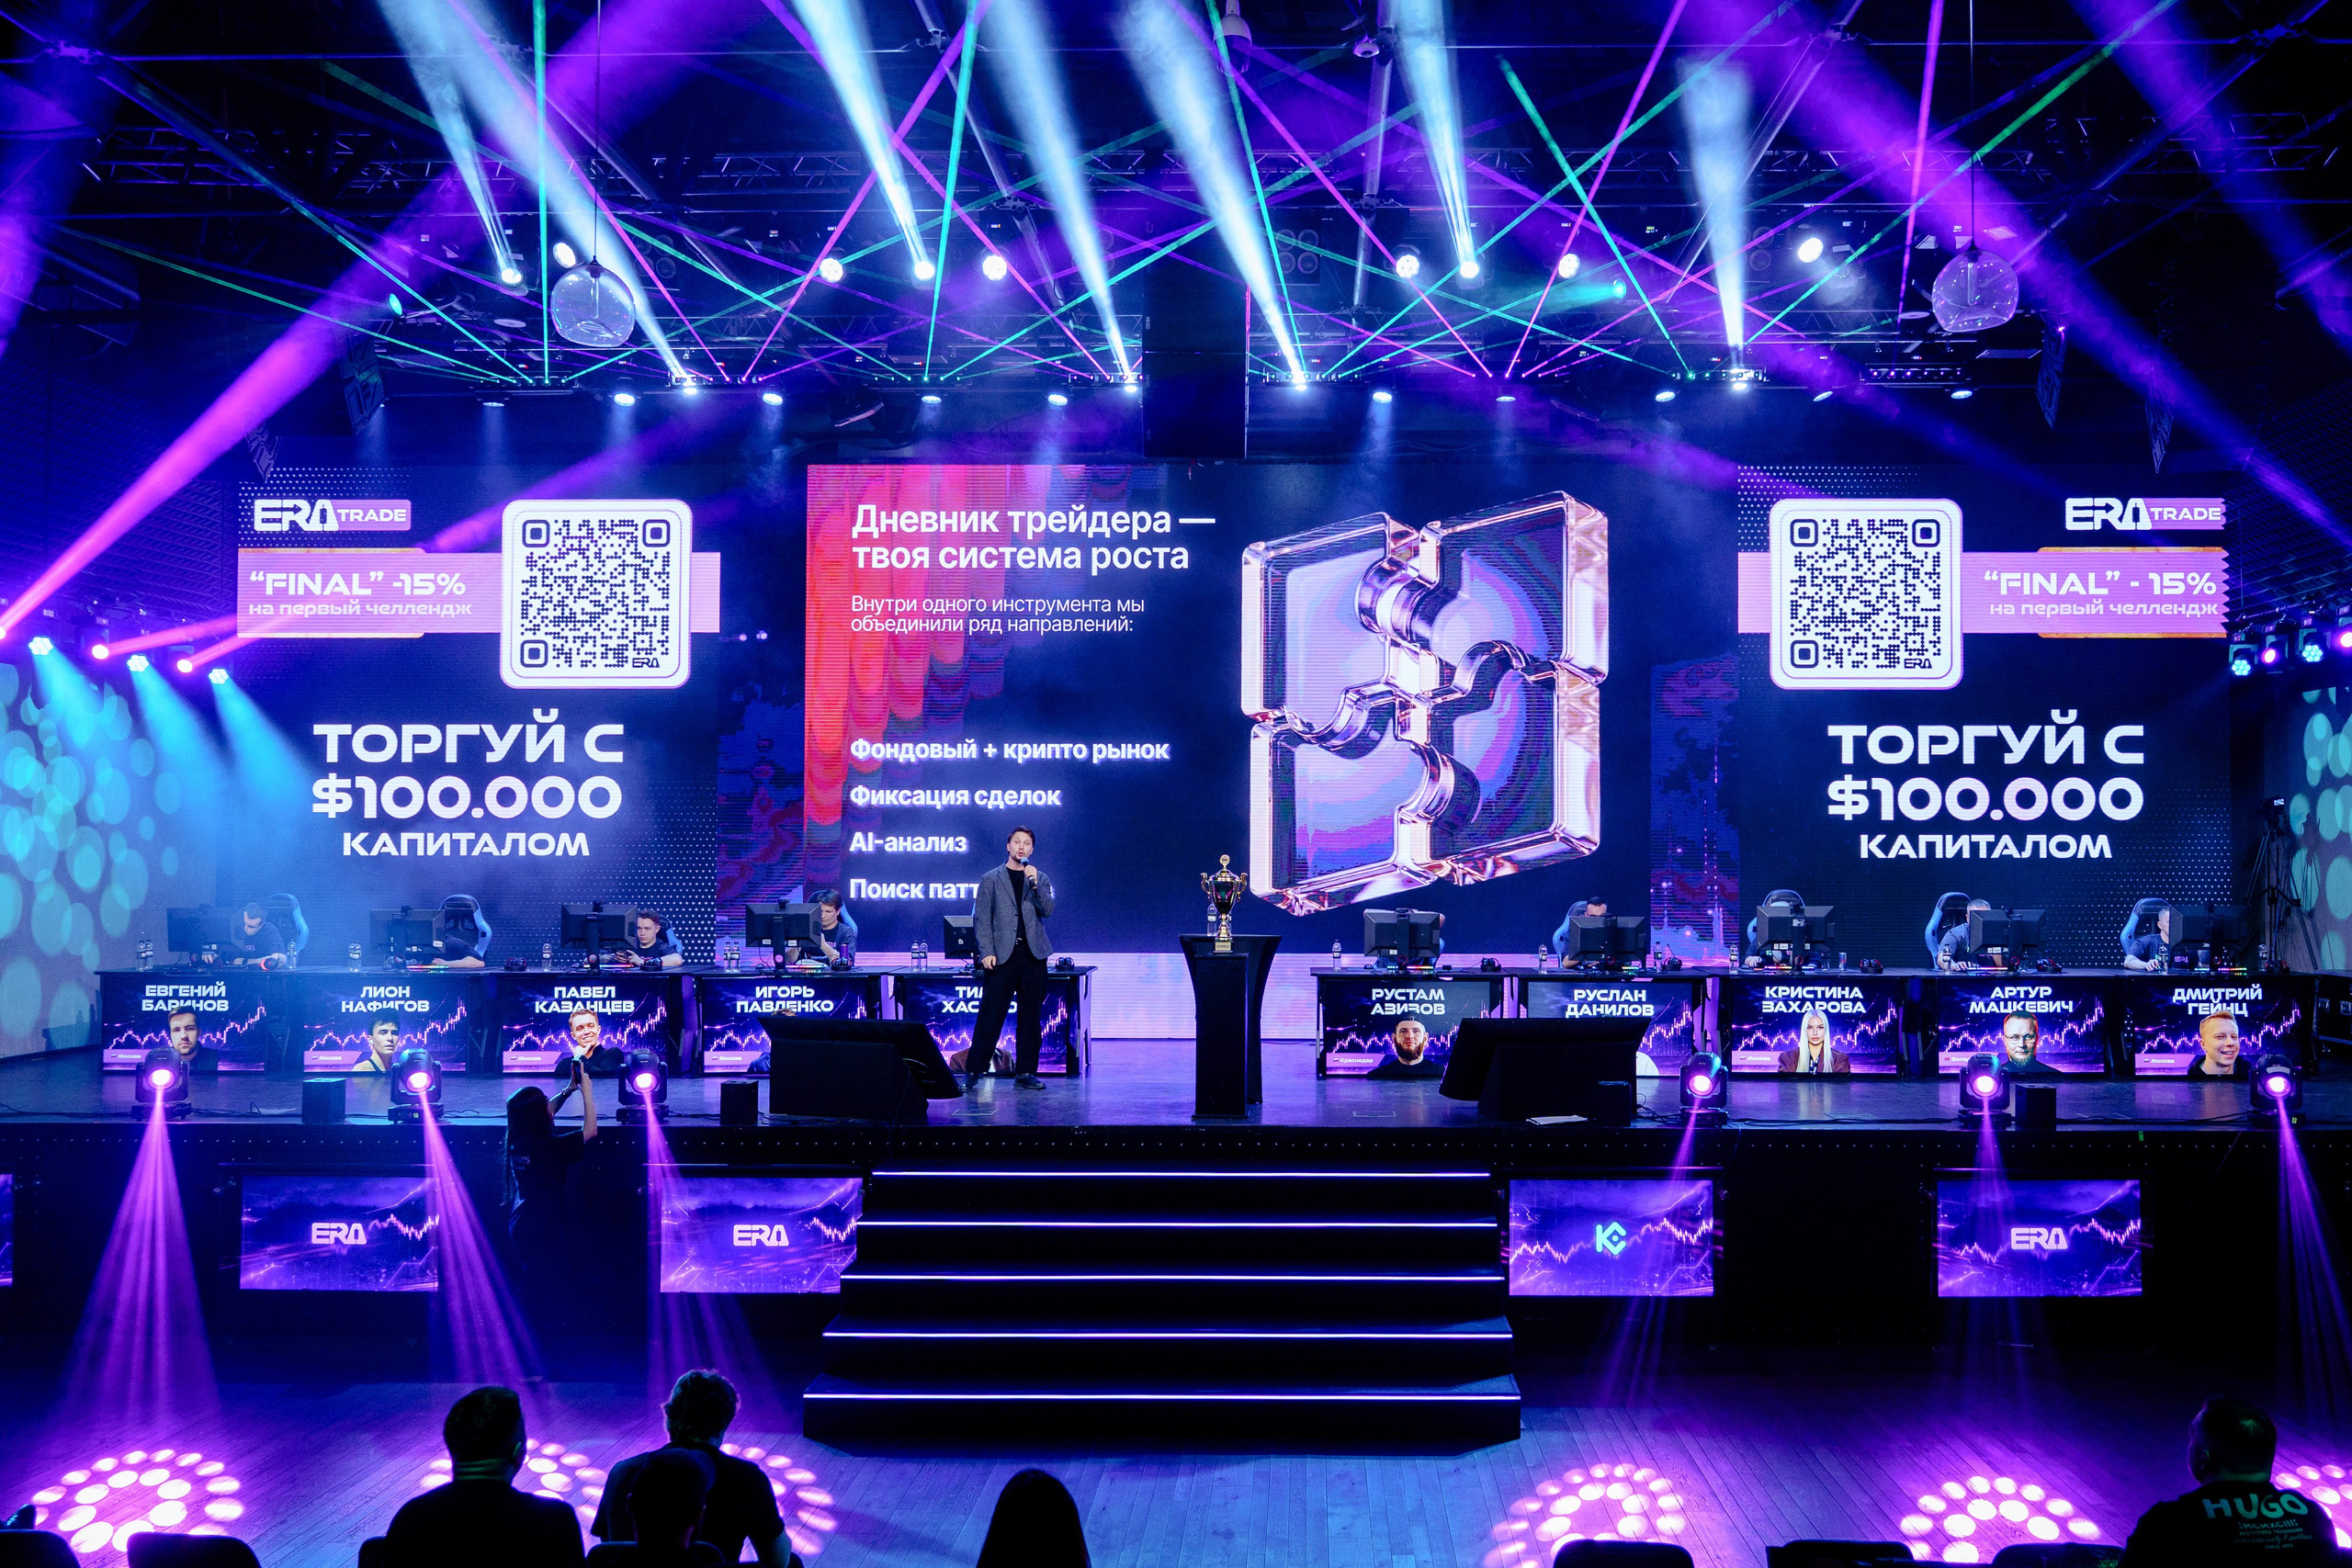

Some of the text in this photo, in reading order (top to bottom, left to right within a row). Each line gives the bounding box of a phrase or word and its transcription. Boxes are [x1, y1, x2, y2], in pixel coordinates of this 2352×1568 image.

[254, 499, 407, 532] ERA TRADE
[852, 504, 1000, 539] Дневник
[1008, 505, 1171, 540] трейдера
[2064, 497, 2222, 531] ERA TRADE
[852, 547, 1189, 576] твоя система роста
[2148, 572, 2217, 595] 15%
[248, 599, 473, 618] на первый челлендж
[852, 595, 1145, 615] Внутри одного инструмента мы
[1989, 599, 2219, 618] на первый челлендж
[851, 614, 1134, 636] объединили ряд направлений:
[631, 657, 661, 669] ERA
[1904, 658, 1933, 670] ERA
[313, 707, 625, 763] ТОРГУЙ С
[1827, 708, 2144, 765] ТОРГУЙ С
[850, 738, 977, 763] Фондовый
[1002, 743, 1088, 764] крипто
[1092, 743, 1170, 764] рынок
[311, 773, 623, 819] $100.000
[850, 784, 1061, 810] Фиксация сделок
[1827, 773, 2144, 821] $100.000
[343, 831, 590, 857] КАПИТАЛОМ
[849, 832, 967, 852] AI-анализ
[1860, 833, 2113, 859] КАПИТАЛОМ
[849, 878, 924, 898] Поиск
[145, 981, 226, 998] ЕВГЕНИЙ
[360, 986, 411, 998] ЛИОН
[554, 986, 616, 998] ПАВЕЛ
[755, 986, 816, 998] ИГОРЬ
[1372, 988, 1445, 1001] РУСТАМ
[1574, 988, 1646, 1002] РУСЛАН
[1765, 986, 1864, 999] КРИСТИНА
[1990, 986, 2052, 999] АРТУР
[2172, 984, 2263, 1004] ДМИТРИЙ
[535, 1000, 635, 1015] КАЗАНЦЕВ
[736, 999, 834, 1013] ПАВЛЕНКО
[1370, 1002, 1446, 1016] АЗИЗОВ
[1565, 1003, 1655, 1018] ДАНИЛОВ
[1761, 1000, 1867, 1014] ЗАХАРОВА
[1969, 1000, 2074, 1014] МАЦКЕВИЧ
[2188, 998, 2248, 1017] ГЕЙНЦ
[1340, 1057, 1374, 1066] Краснодар
[311, 1222, 367, 1246] ERA
[732, 1224, 790, 1247] ERA
[2010, 1227, 2068, 1250] ERA
[2201, 1493, 2309, 1518] HUGO
